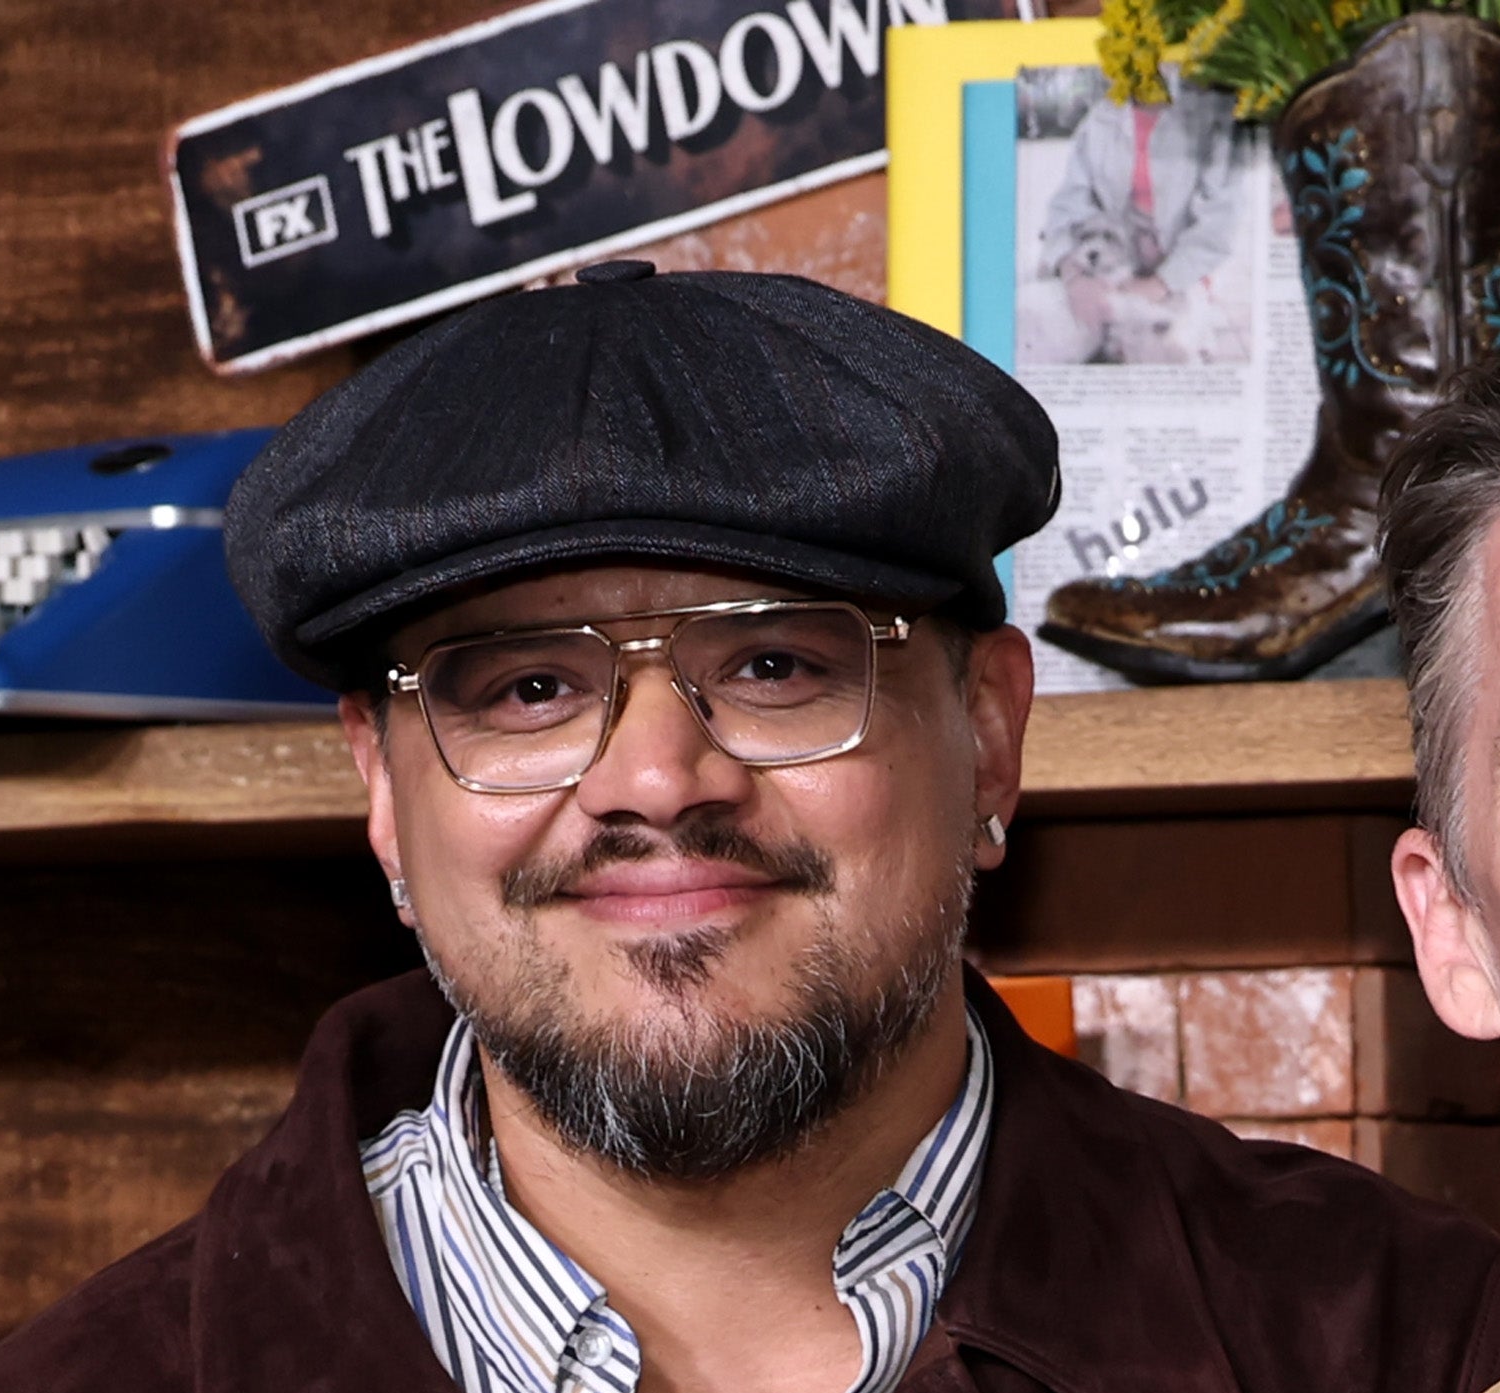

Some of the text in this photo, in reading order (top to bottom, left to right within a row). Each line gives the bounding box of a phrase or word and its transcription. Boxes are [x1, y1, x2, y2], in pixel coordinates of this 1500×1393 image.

[255, 193, 315, 249] FX
[343, 117, 458, 238] THE
[1064, 477, 1209, 572] hulu
